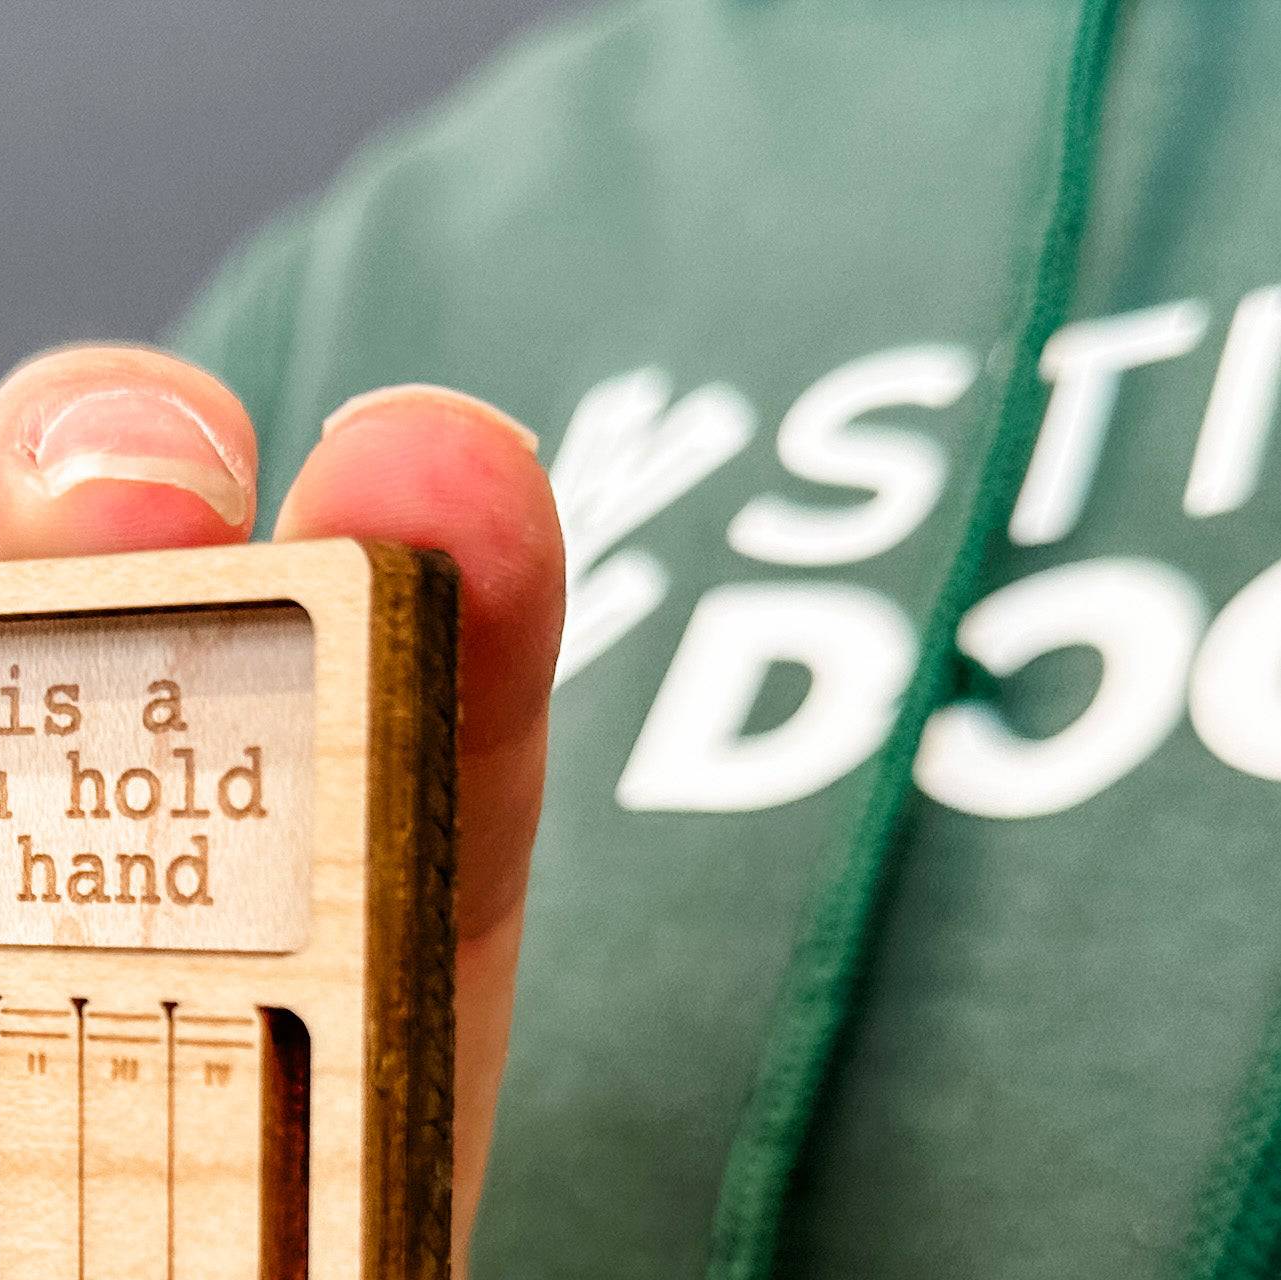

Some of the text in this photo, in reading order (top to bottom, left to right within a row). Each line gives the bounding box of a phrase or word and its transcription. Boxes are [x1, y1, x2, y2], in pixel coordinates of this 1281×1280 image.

[141, 677, 189, 734] a
[65, 746, 268, 821] hold
[16, 835, 214, 908] hand
